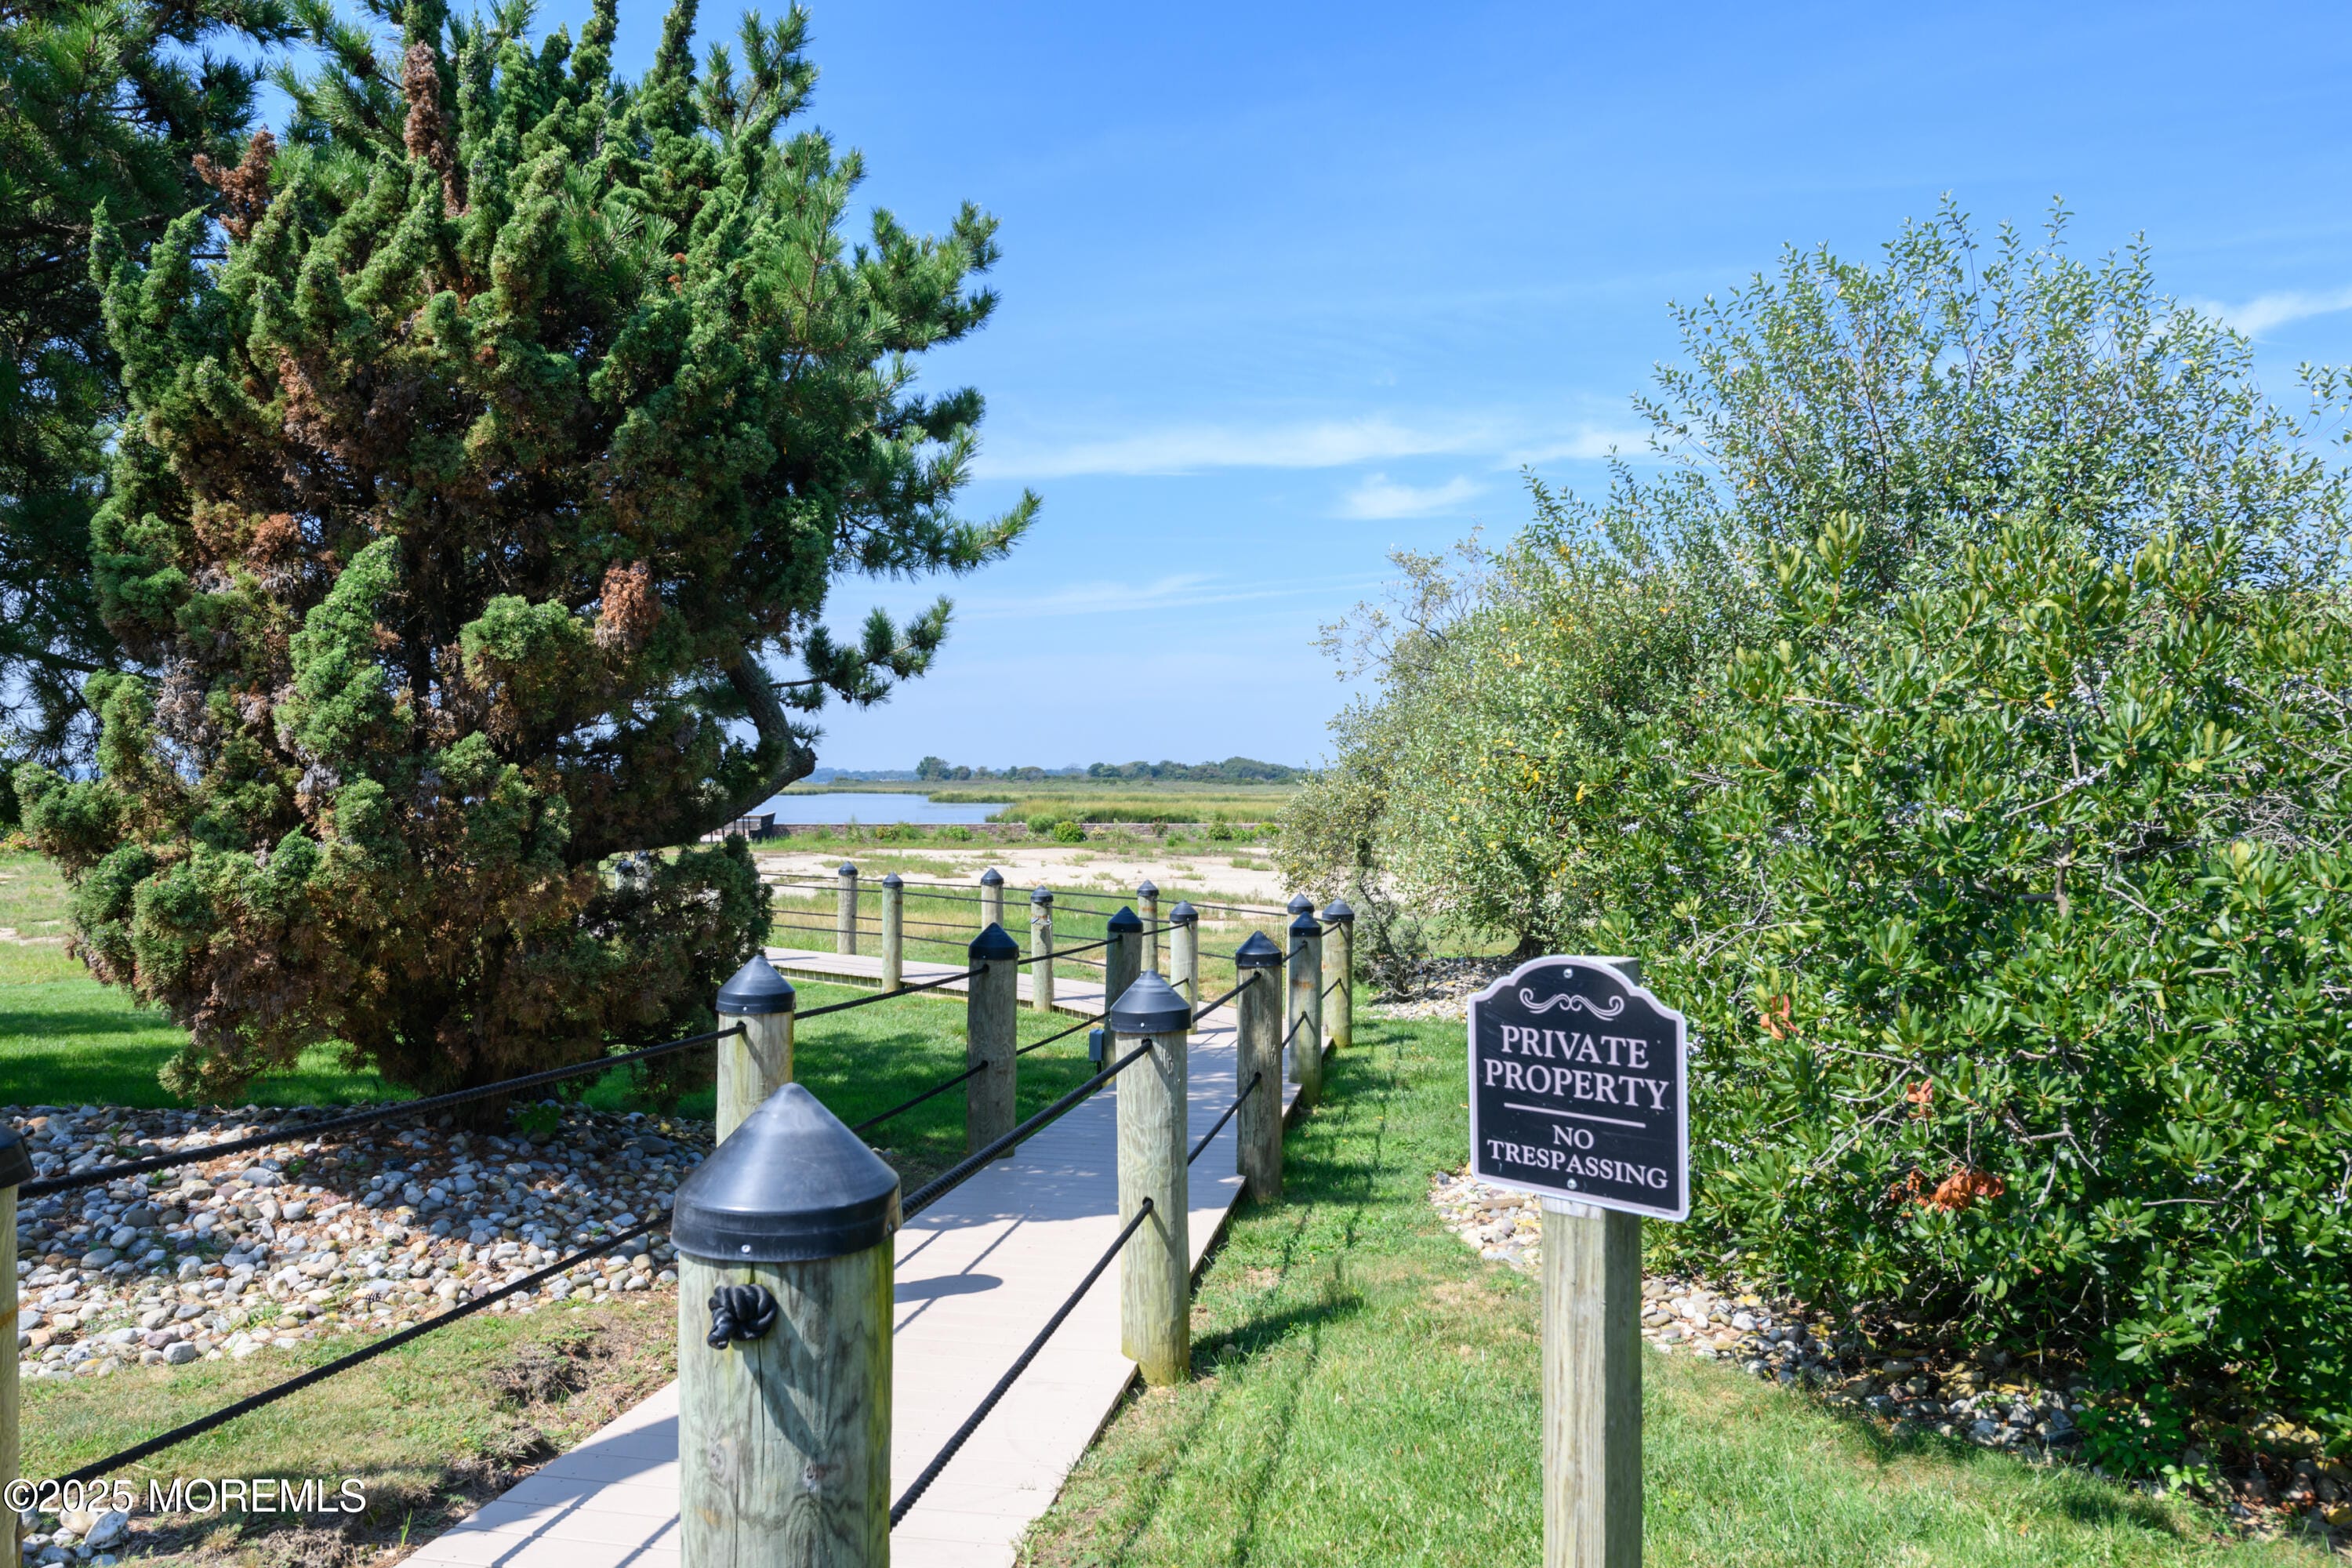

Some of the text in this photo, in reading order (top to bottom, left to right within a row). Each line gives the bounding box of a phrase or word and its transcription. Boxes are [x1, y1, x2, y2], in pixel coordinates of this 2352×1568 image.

[1500, 1025, 1650, 1069] PRIVATE
[1484, 1058, 1669, 1110] PROPERTY
[1552, 1125, 1595, 1149] NO
[1487, 1140, 1668, 1189] TRESPASSING
